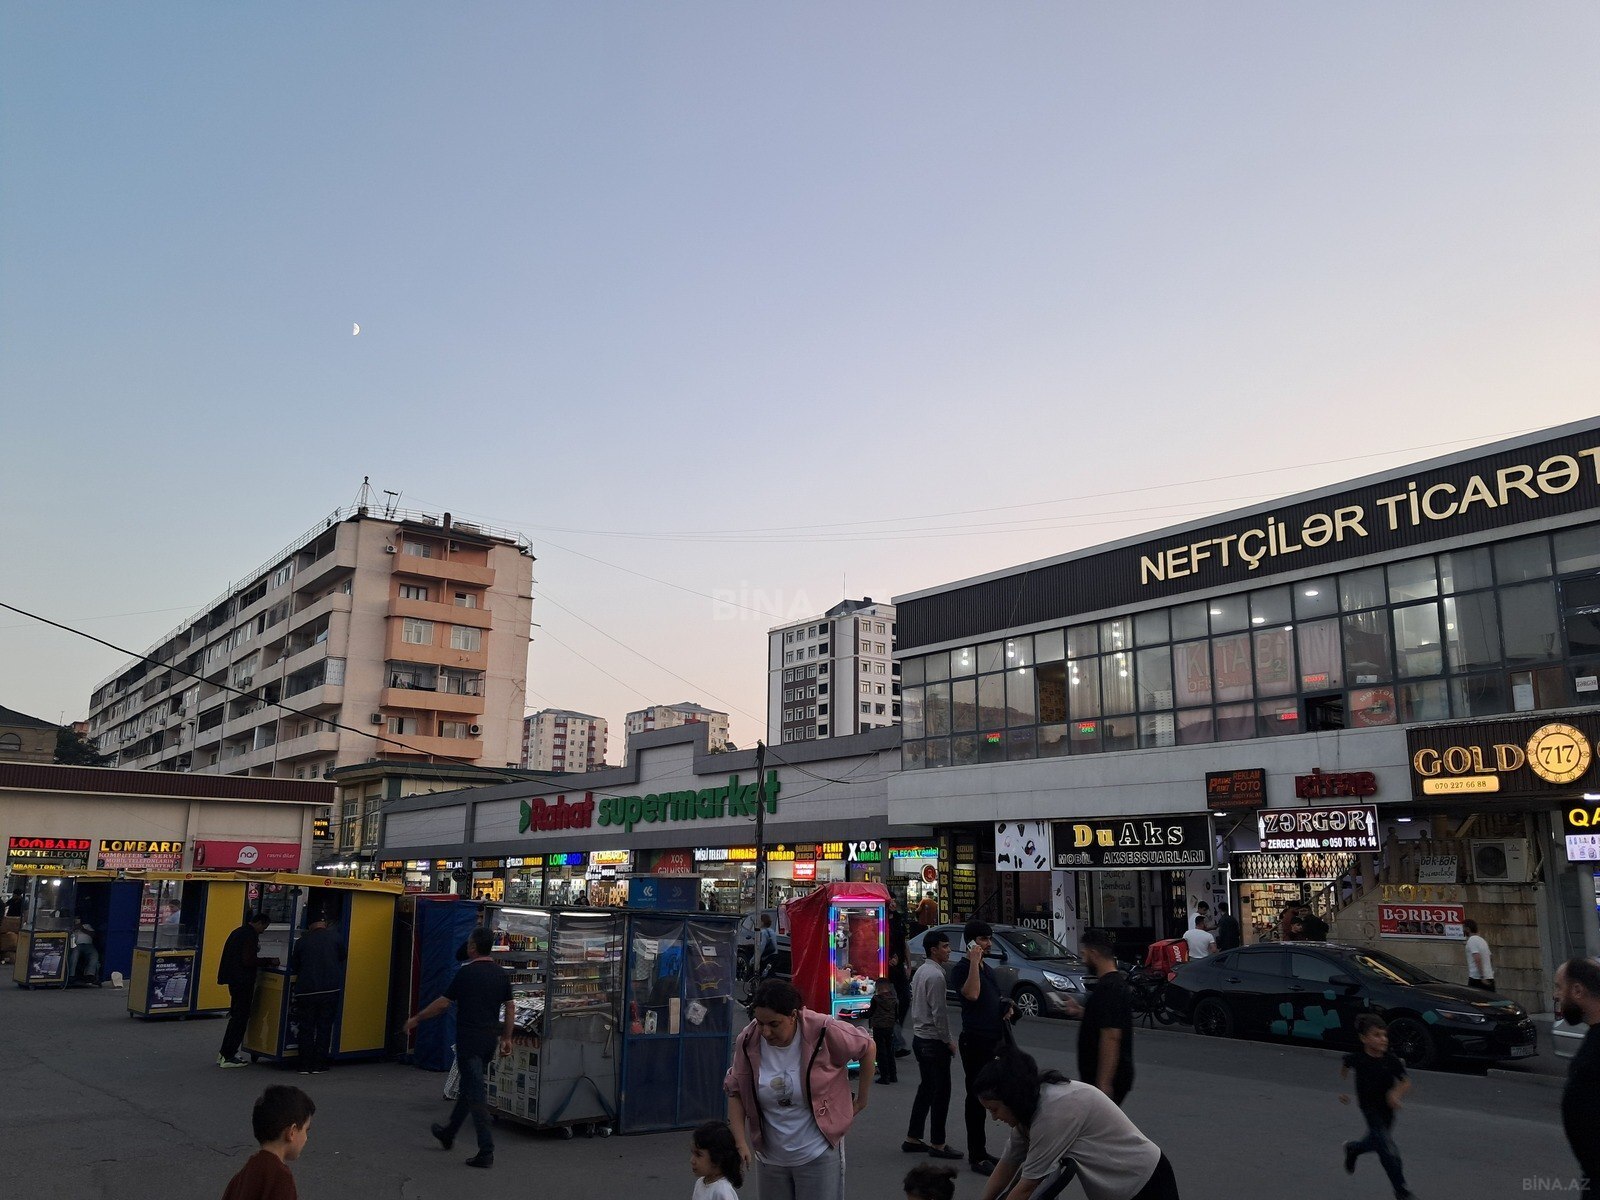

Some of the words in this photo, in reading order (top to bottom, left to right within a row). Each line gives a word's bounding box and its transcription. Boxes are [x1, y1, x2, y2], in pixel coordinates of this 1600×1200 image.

[1140, 505, 1369, 584] NEFTÇİLƏR
[1414, 743, 1525, 776] GOLD
[1541, 745, 1574, 764] 717
[1234, 780, 1261, 791] FOTO
[1434, 781, 1448, 790] 070
[1451, 781, 1463, 789] 227
[1465, 780, 1476, 788] 66
[1477, 780, 1487, 788] 88
[530, 790, 594, 832] Rahat
[598, 769, 780, 833] supermarket
[1264, 811, 1366, 833] ZƏRGƏR
[10, 837, 91, 850] LOMBARD
[101, 840, 183, 852] LOMBARD
[823, 842, 843, 853] FENIX
[1330, 837, 1342, 848] 050
[9, 850, 32, 858] NOT
[35, 850, 88, 859] TELECOM
[549, 853, 583, 866] LOMBARD
[767, 851, 795, 861] LOMBARD
[1103, 850, 1205, 864] AKSESSUARLARI
[1383, 908, 1461, 922] BƏRBƏR
